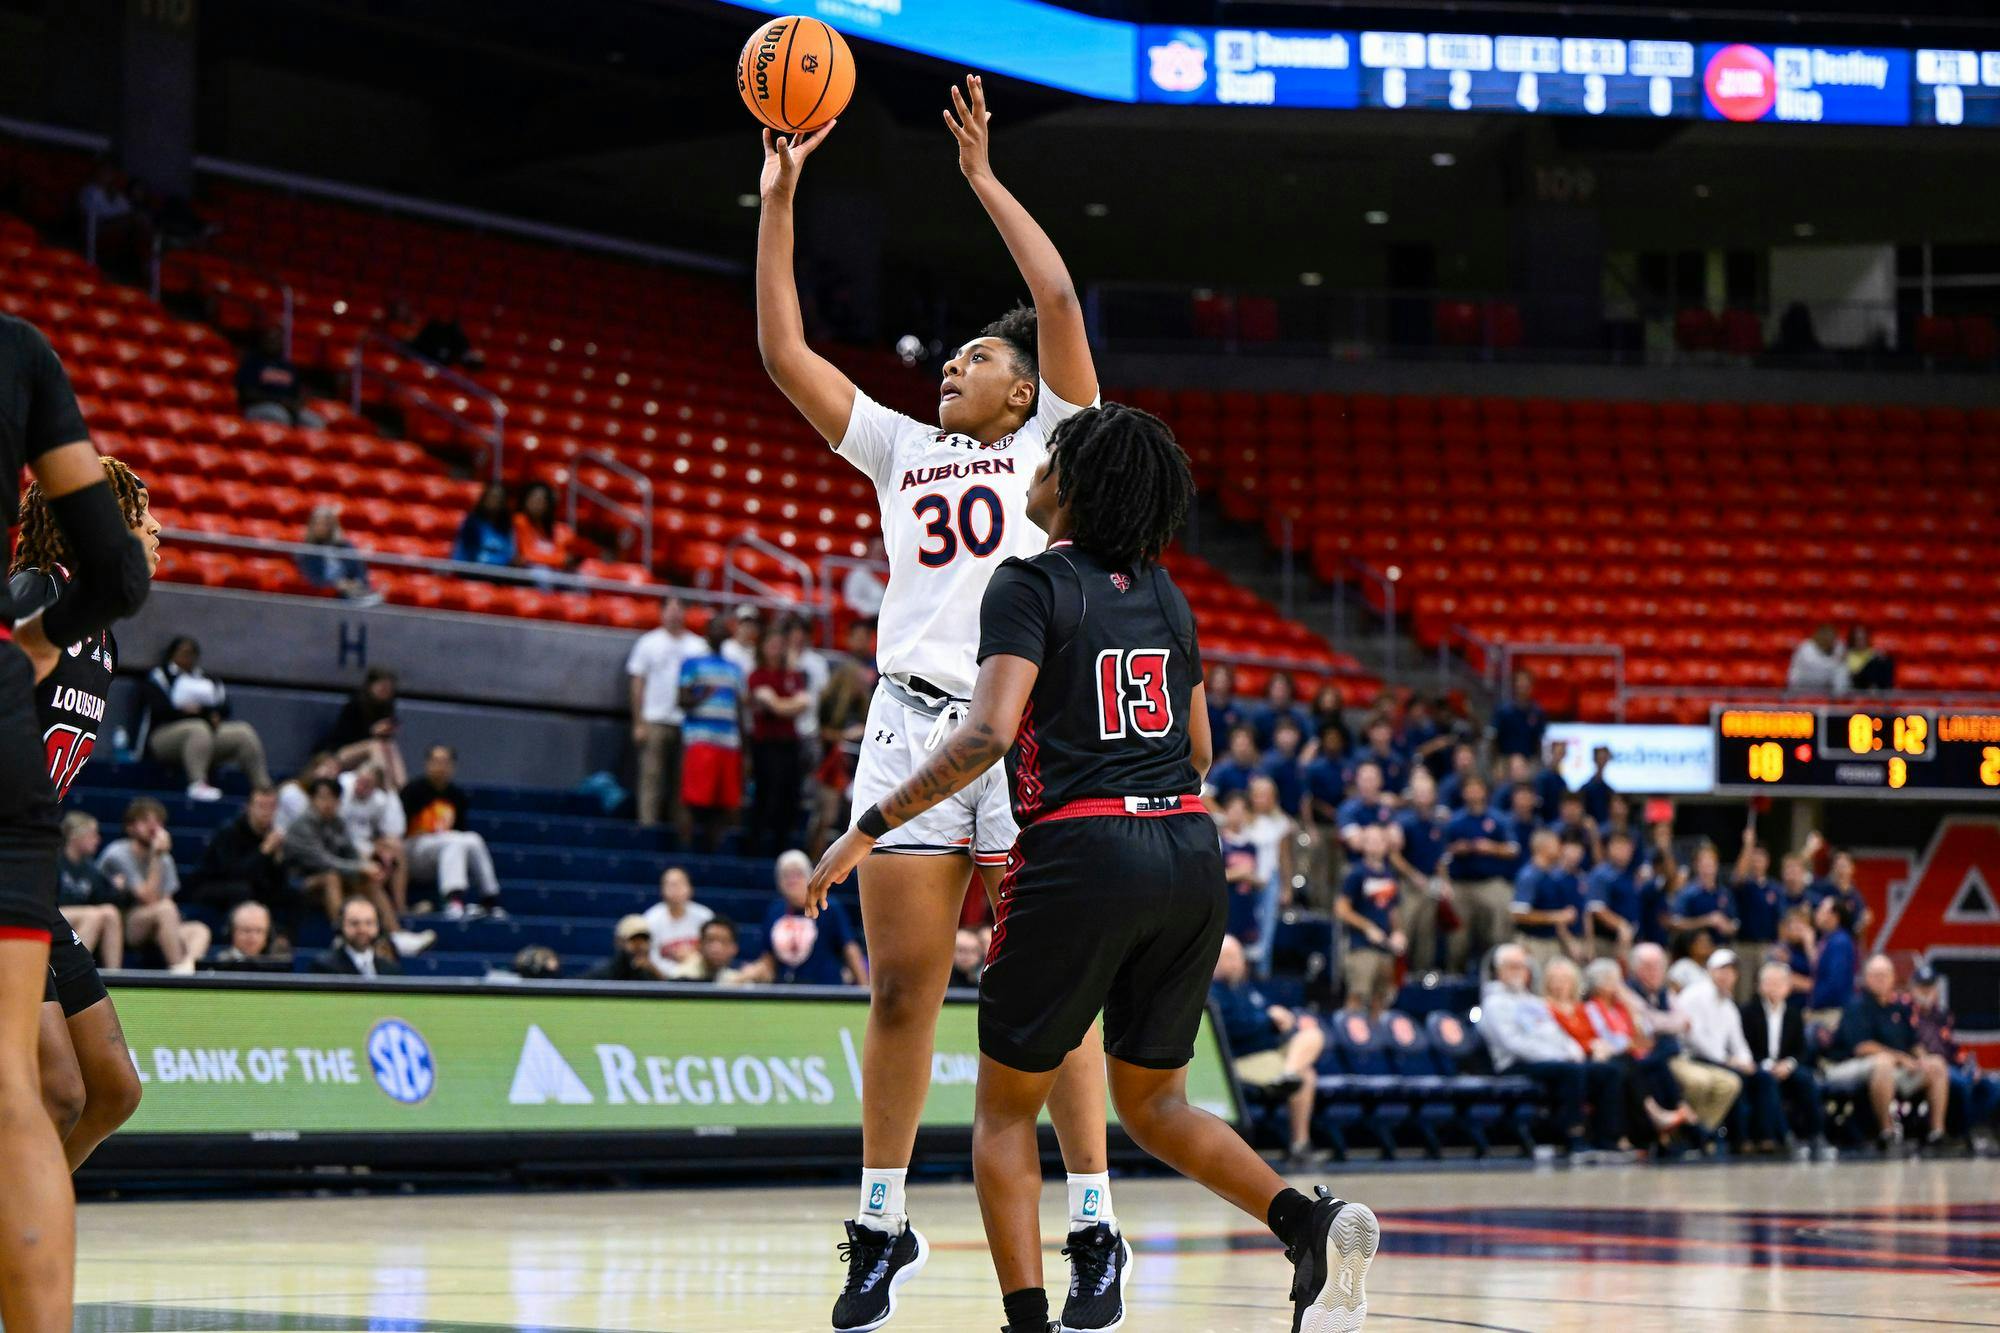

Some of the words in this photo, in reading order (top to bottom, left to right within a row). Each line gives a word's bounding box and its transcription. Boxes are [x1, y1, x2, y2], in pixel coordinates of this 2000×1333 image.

[756, 24, 788, 100] Wilson
[900, 457, 1015, 491] AUBURN
[911, 484, 1005, 568] 30
[338, 621, 368, 669] H
[1095, 649, 1174, 740] 13
[154, 1048, 245, 1084] BANK
[247, 1047, 290, 1084] OF
[295, 1048, 361, 1084] THE
[369, 1018, 434, 1102] SEC
[594, 1043, 834, 1105] REGIONS
